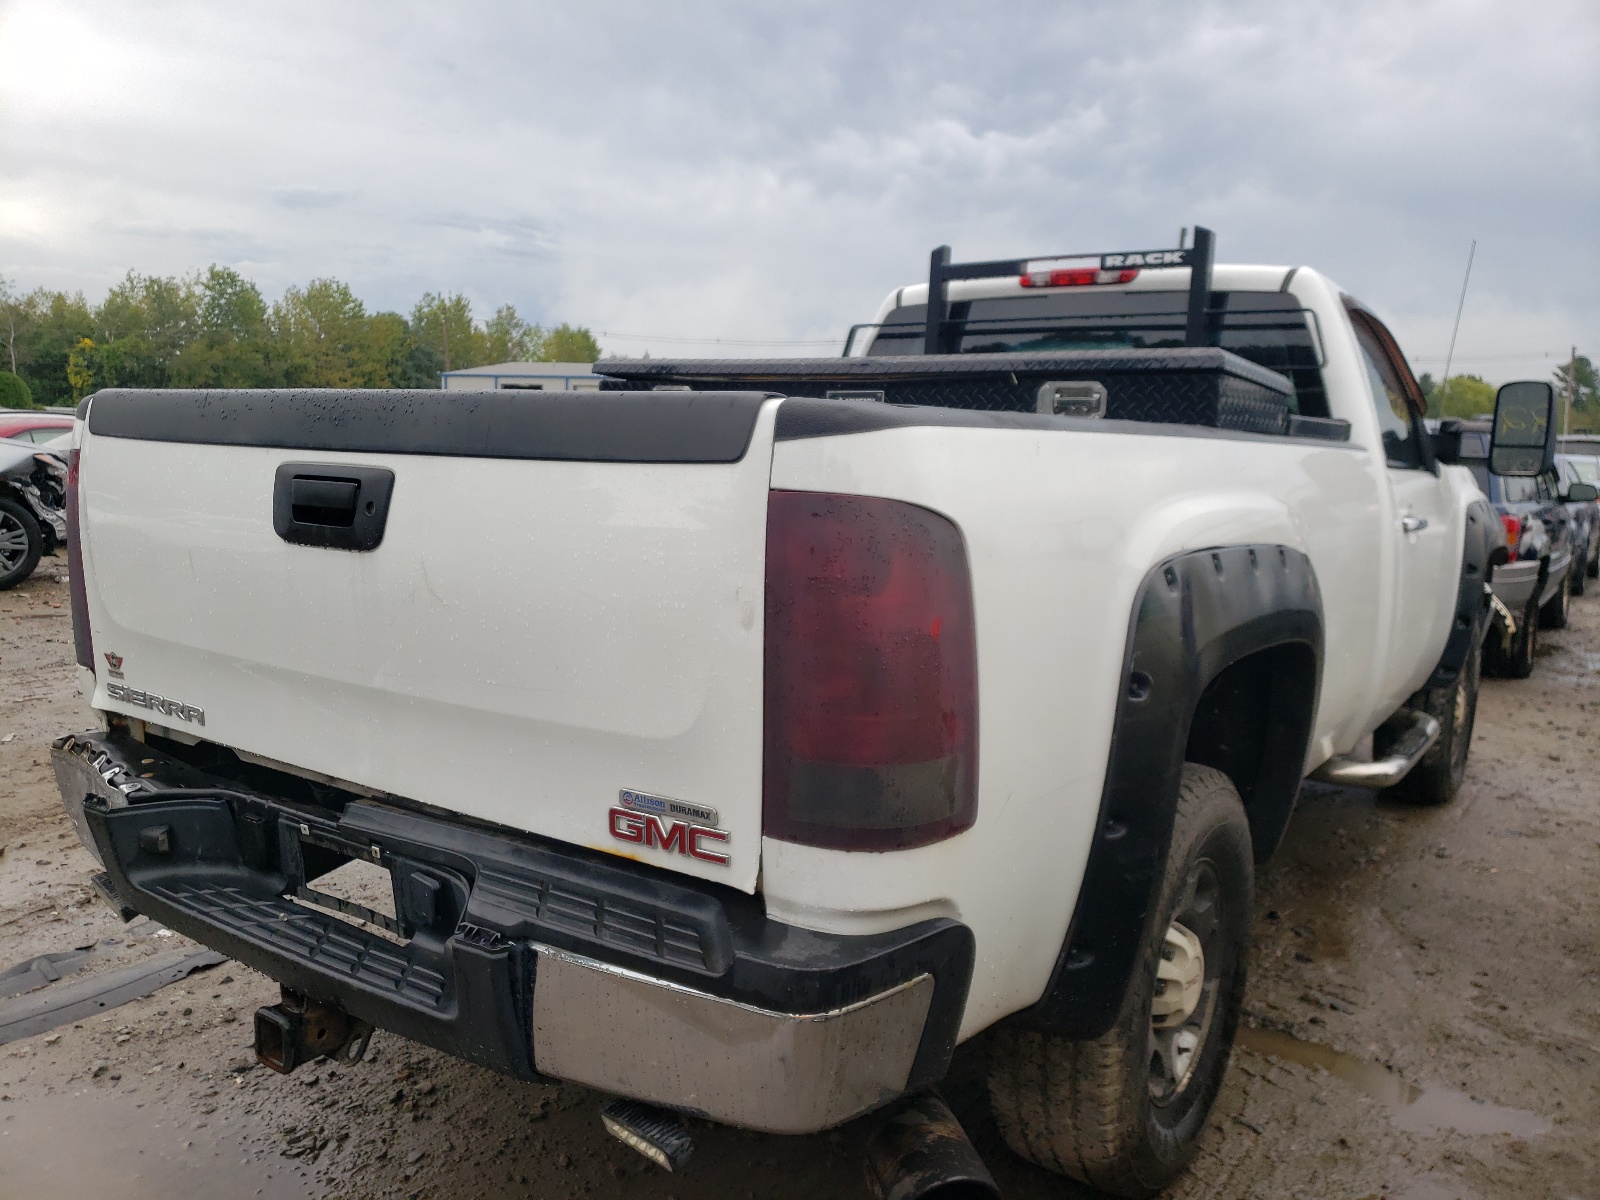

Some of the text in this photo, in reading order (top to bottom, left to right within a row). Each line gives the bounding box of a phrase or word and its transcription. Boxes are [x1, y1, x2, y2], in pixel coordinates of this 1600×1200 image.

[1105, 251, 1185, 267] RACK
[107, 681, 205, 726] SIERRA
[634, 794, 666, 808] Allison
[669, 803, 711, 820] DURAMAX
[609, 806, 731, 867] GMC
